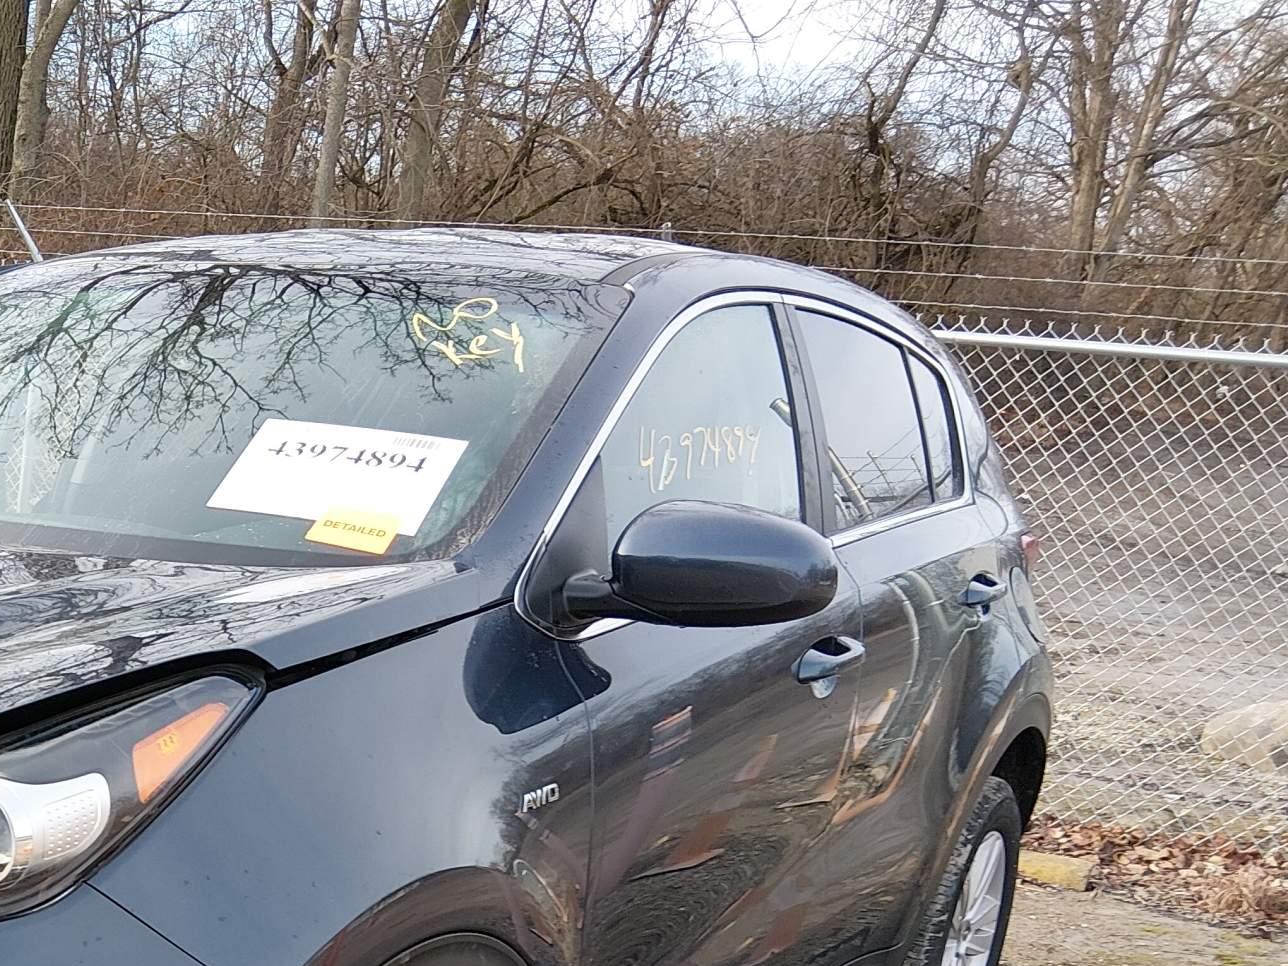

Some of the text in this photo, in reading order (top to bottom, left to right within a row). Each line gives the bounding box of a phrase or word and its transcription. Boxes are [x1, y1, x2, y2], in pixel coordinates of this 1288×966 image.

[267, 439, 430, 474] 43974894
[322, 518, 387, 539] DETAILED
[521, 782, 560, 813] AWD
